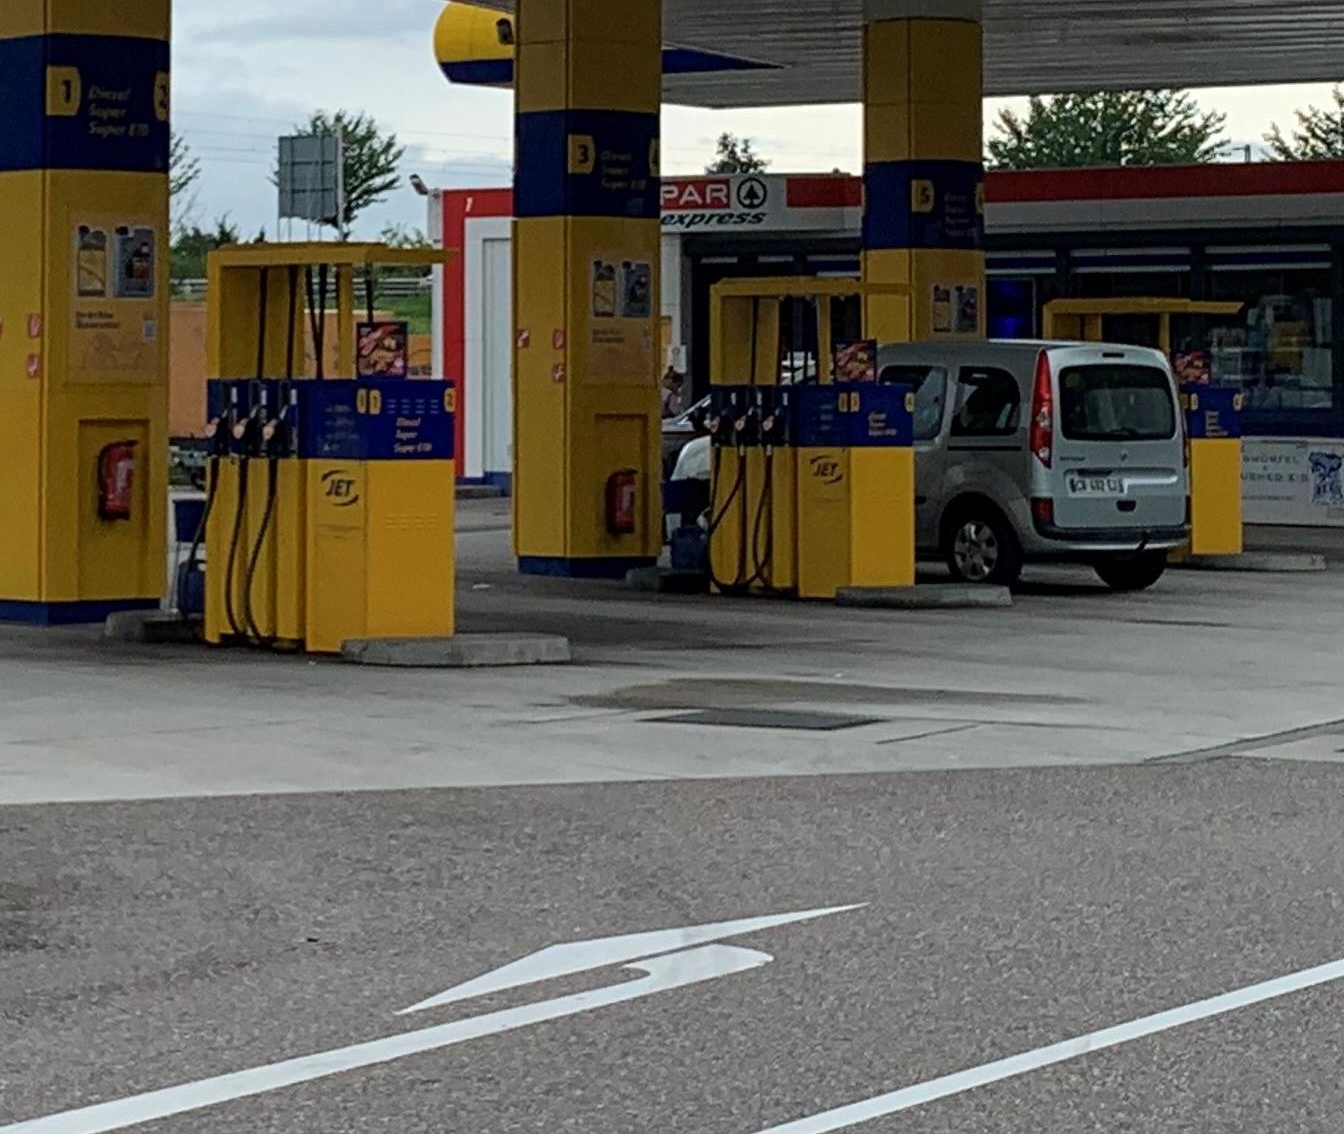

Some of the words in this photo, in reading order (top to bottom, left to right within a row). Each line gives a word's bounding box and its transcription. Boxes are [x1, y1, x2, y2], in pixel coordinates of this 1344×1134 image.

[61, 79, 72, 105] 1
[88, 103, 128, 121] Super
[88, 121, 128, 139] Super
[578, 144, 589, 164] 3
[659, 183, 729, 206] PAR
[660, 211, 768, 229] express
[812, 462, 839, 477] JET
[325, 479, 356, 497] JET
